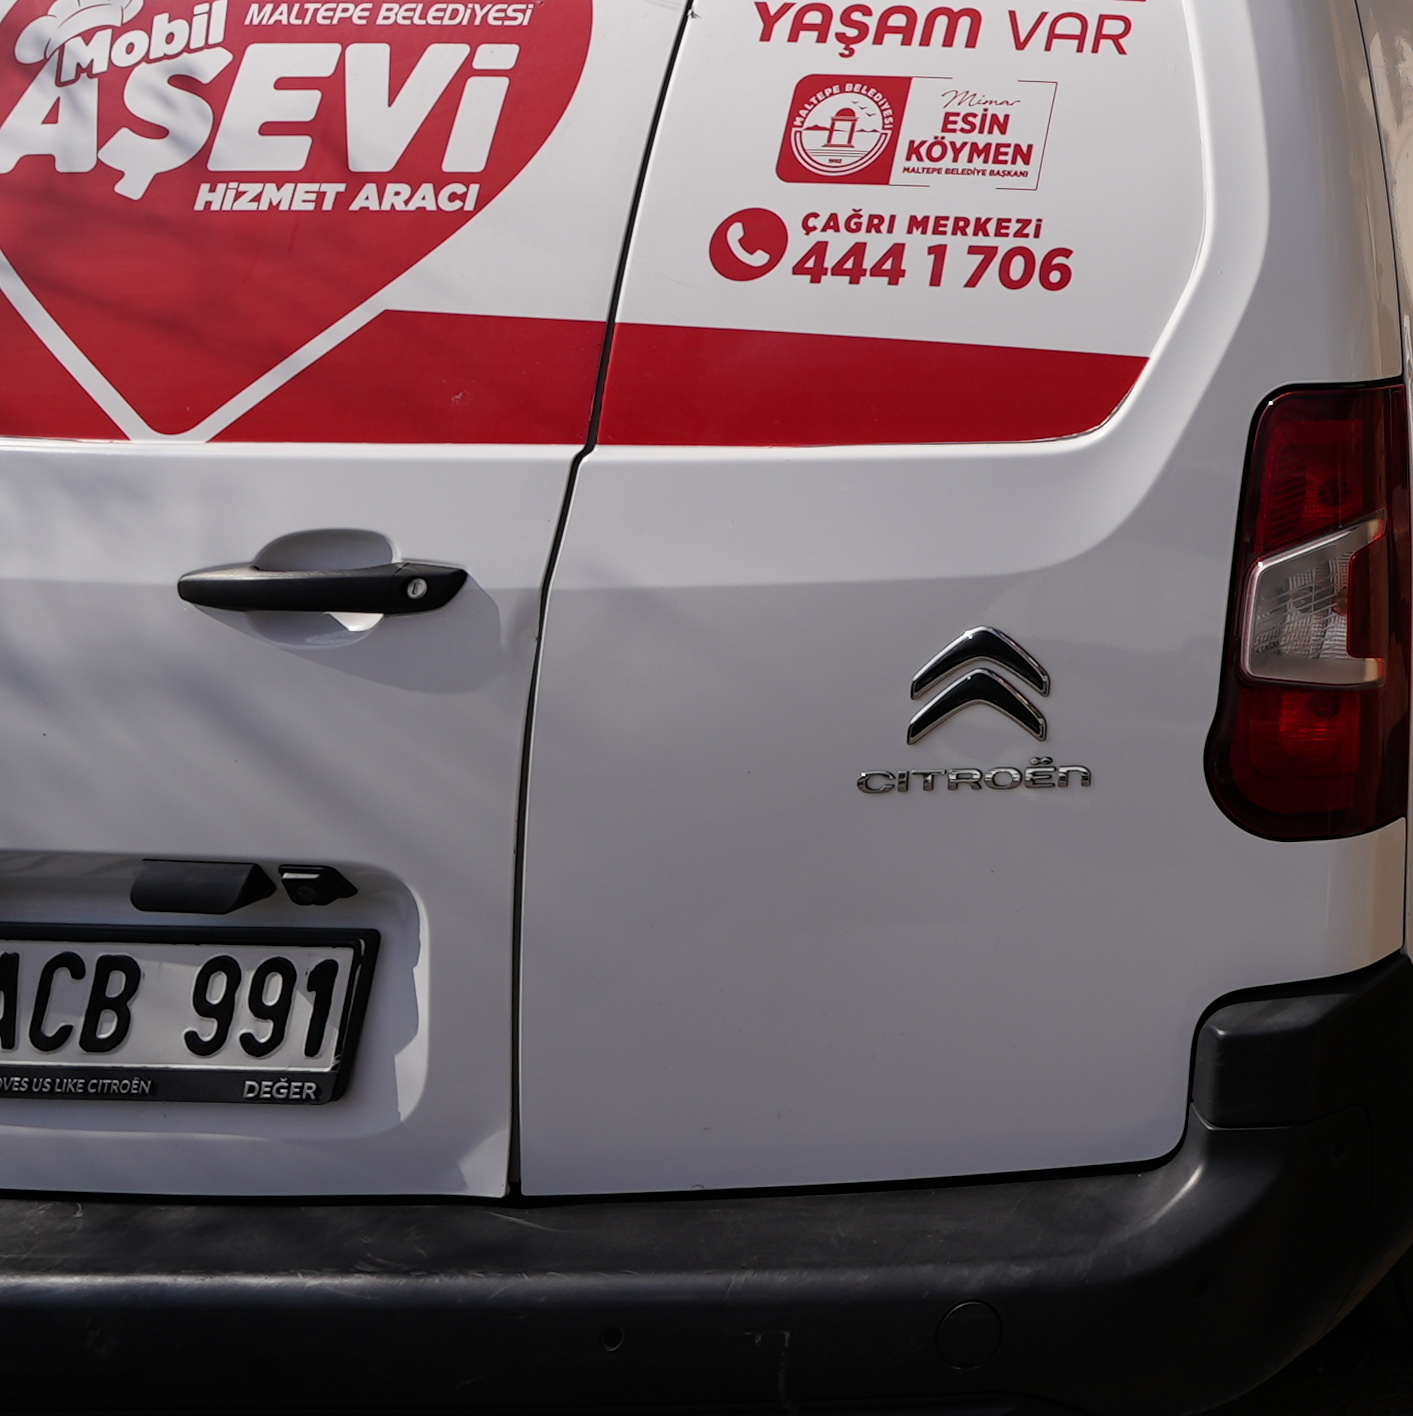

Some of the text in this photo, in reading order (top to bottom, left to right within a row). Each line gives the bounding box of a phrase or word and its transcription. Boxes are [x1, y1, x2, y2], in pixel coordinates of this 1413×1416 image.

[244, 3, 371, 25] MALTEPE
[754, 1, 1133, 58] YAŞAM VAR
[793, 84, 841, 126] MALTEPE
[941, 90, 1021, 109] Mimar
[941, 108, 1010, 135] ESİN
[905, 136, 1034, 165] KÖYMEN
[902, 166, 943, 175] MALTEPE
[348, 184, 480, 211] ARACI
[802, 209, 896, 236] ÇAĞRI
[792, 241, 906, 286] 444
[184, 954, 339, 1058] 991
[0, 1076, 152, 1094] VES US LIKE CITROËN
[243, 1077, 317, 1100] DEĞER
